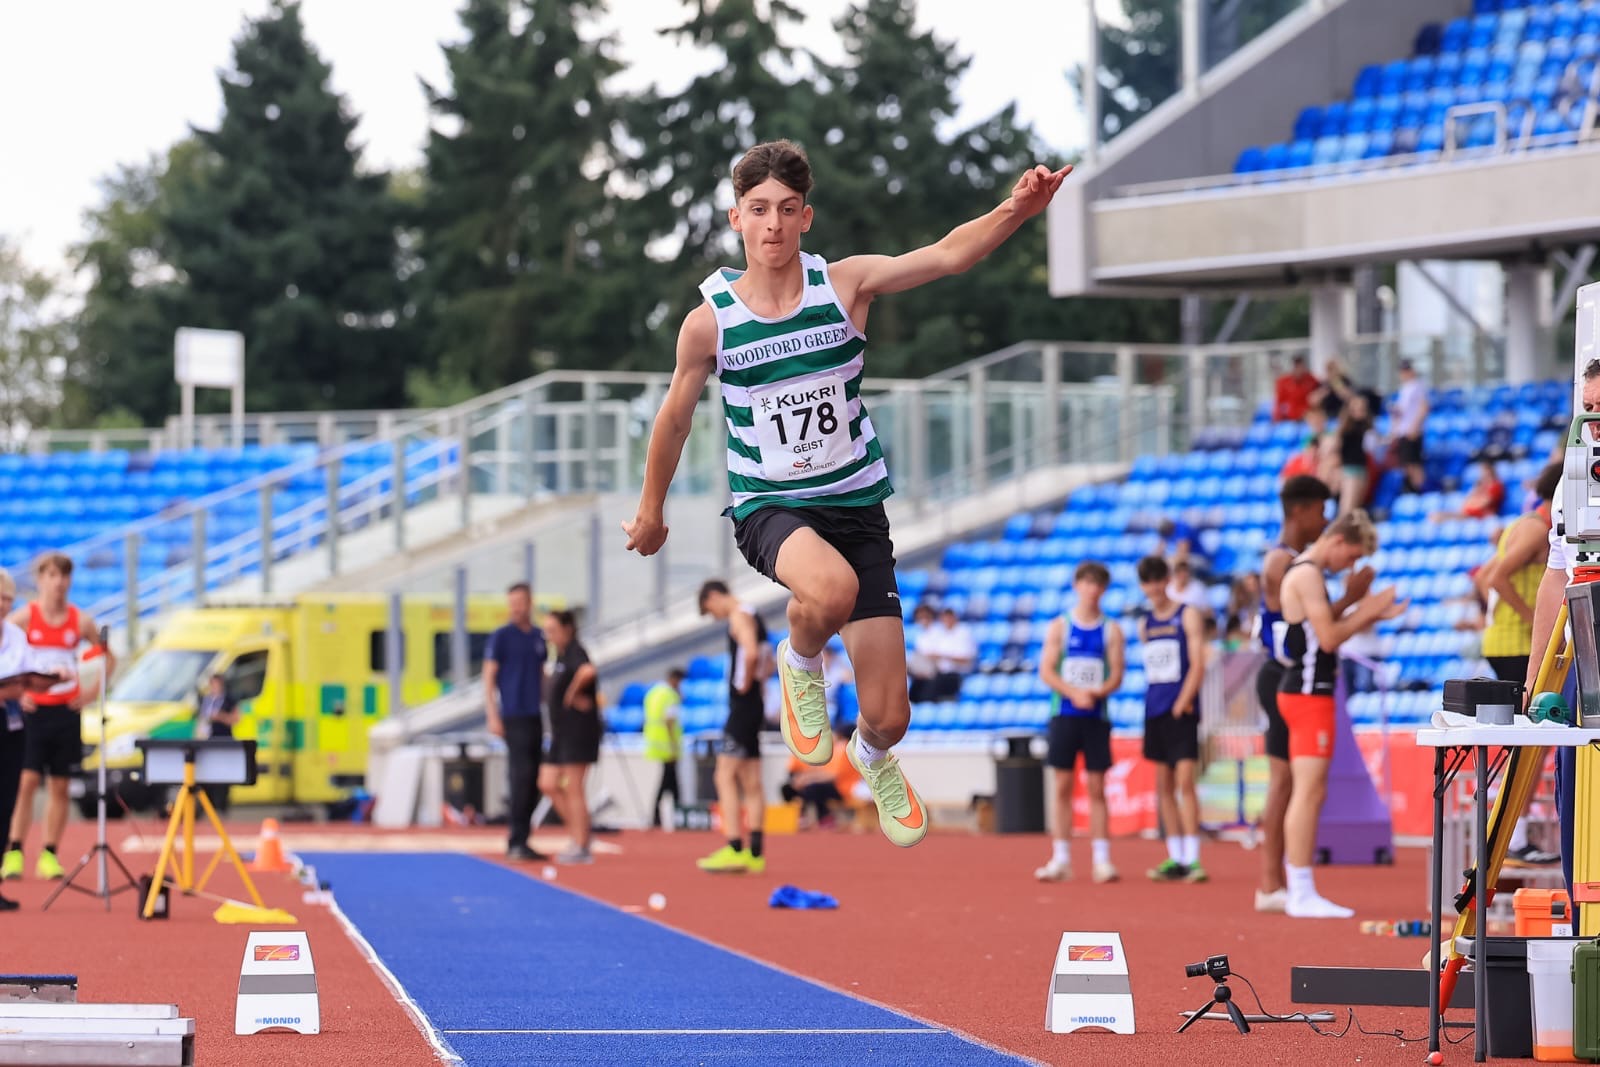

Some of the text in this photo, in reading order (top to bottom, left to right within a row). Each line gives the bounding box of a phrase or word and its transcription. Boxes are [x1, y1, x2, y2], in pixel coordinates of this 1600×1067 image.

[724, 326, 849, 368] WOODFORD GREEN
[776, 385, 836, 409] KUKRI
[770, 402, 838, 445] 178
[793, 439, 824, 454] GEIST
[262, 1016, 301, 1025] MONDO
[1078, 1016, 1116, 1024] MONDO
